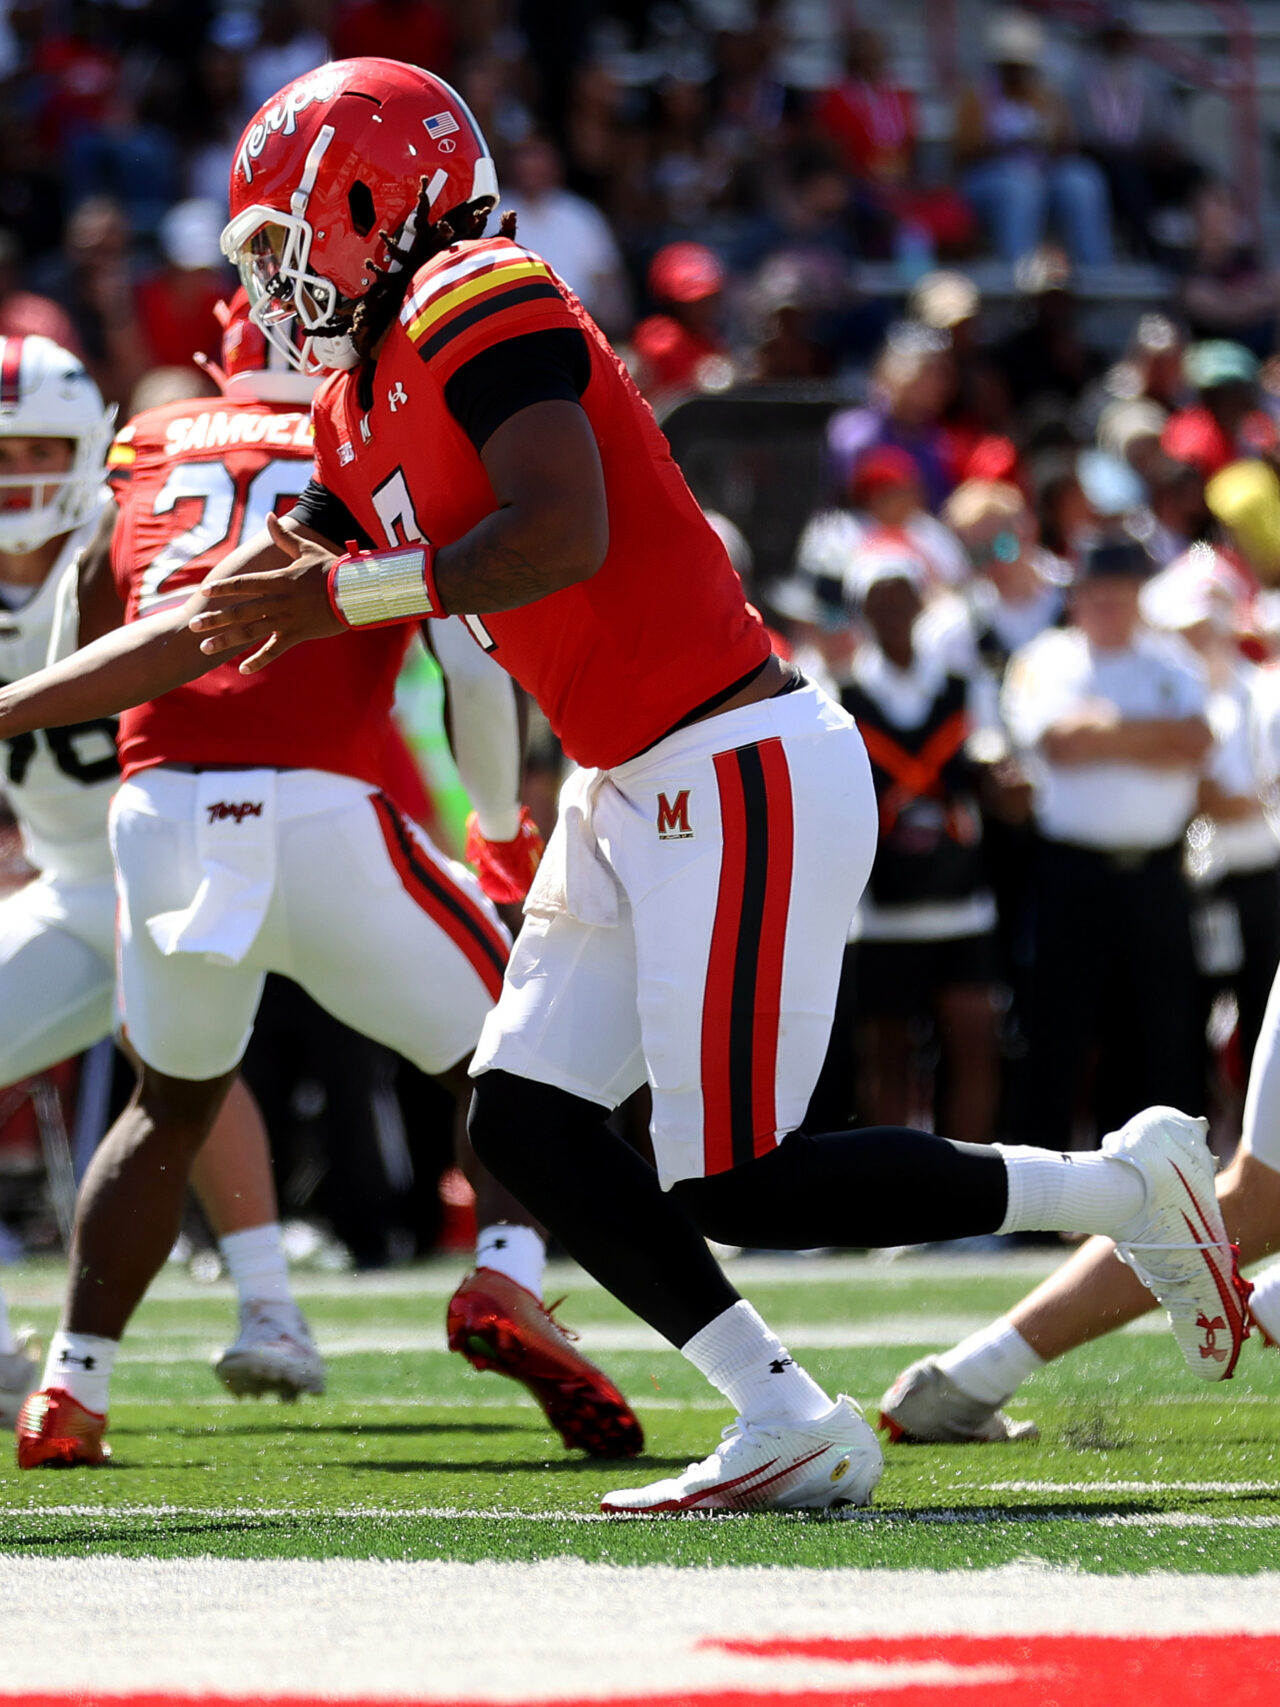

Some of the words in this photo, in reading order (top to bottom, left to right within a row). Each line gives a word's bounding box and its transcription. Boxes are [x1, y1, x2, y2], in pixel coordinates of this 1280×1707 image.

[164, 410, 314, 456] SAMUEL
[206, 801, 263, 824] Terps
[656, 789, 693, 834] M
